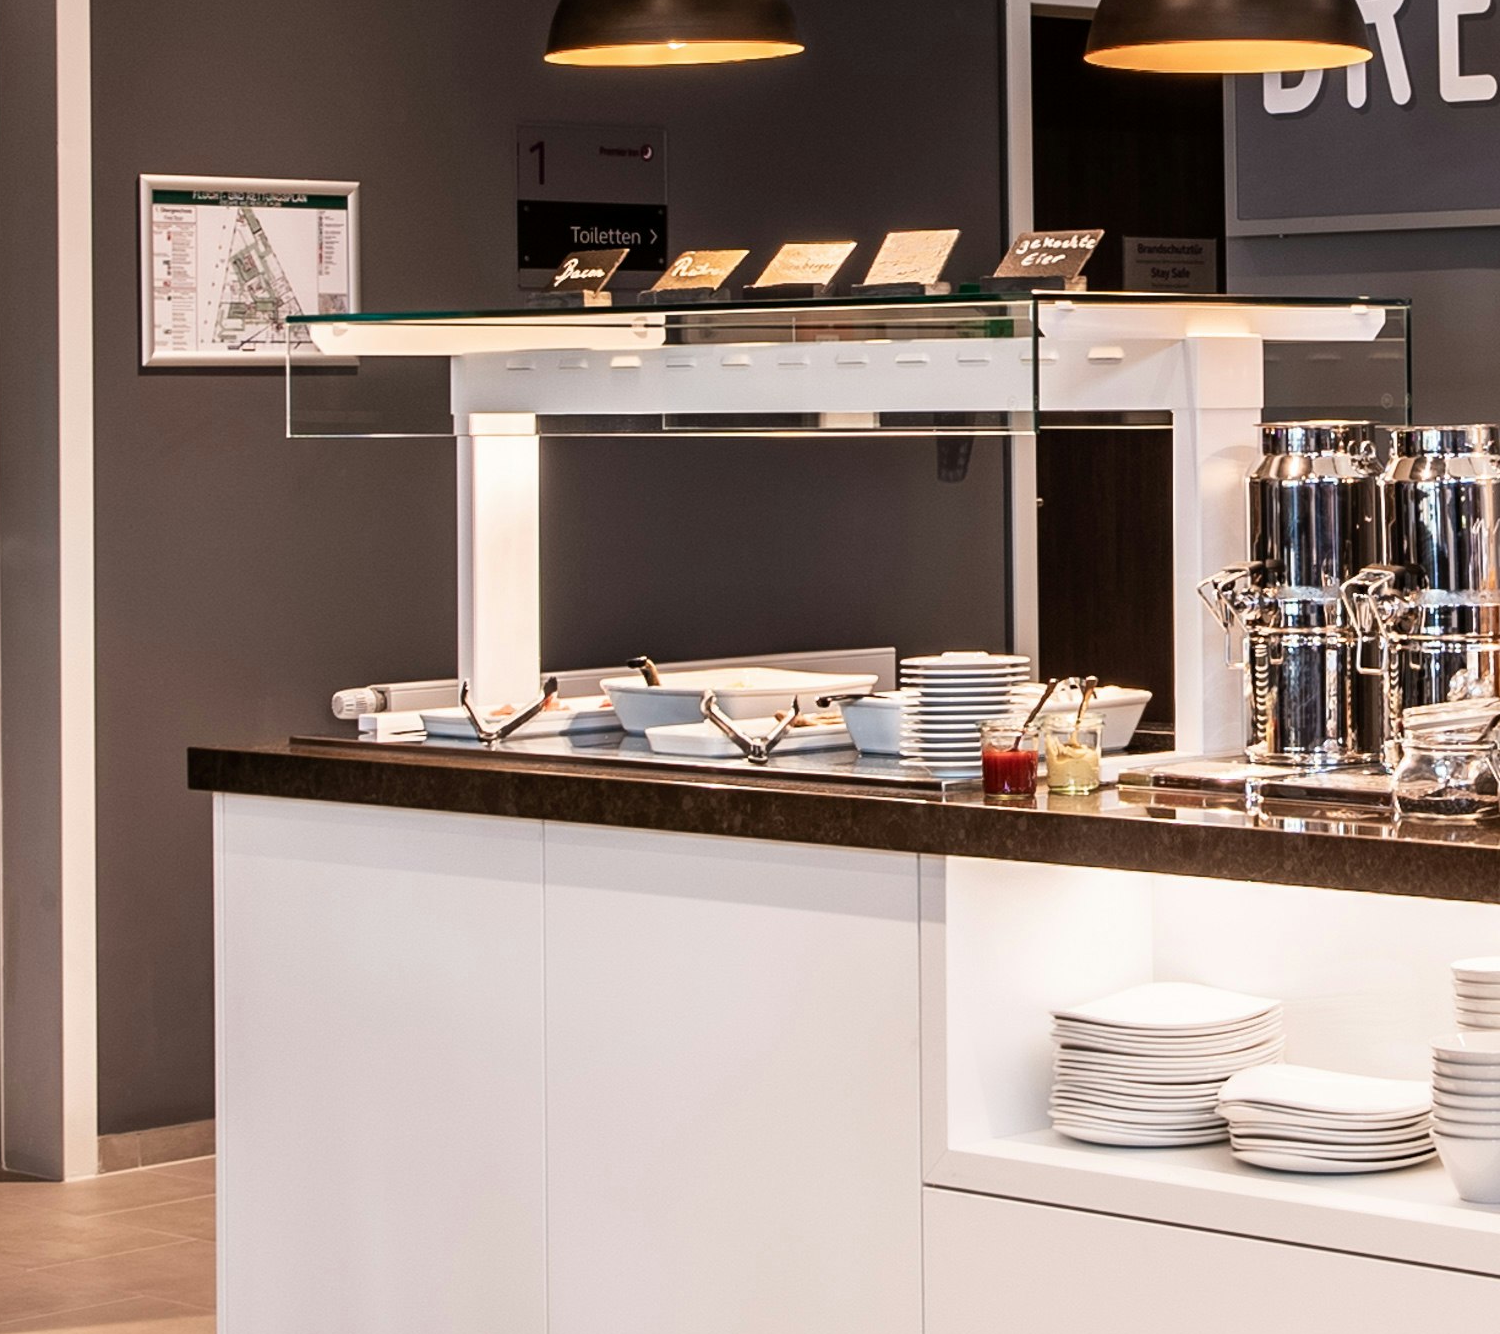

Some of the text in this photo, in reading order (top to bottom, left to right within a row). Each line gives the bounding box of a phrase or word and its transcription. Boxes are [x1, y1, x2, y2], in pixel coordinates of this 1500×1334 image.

[529, 141, 546, 185] 1
[570, 225, 642, 245] Toiletten
[1136, 243, 1204, 256] Brandschutztür
[1150, 267, 1191, 280] Stay Safe
